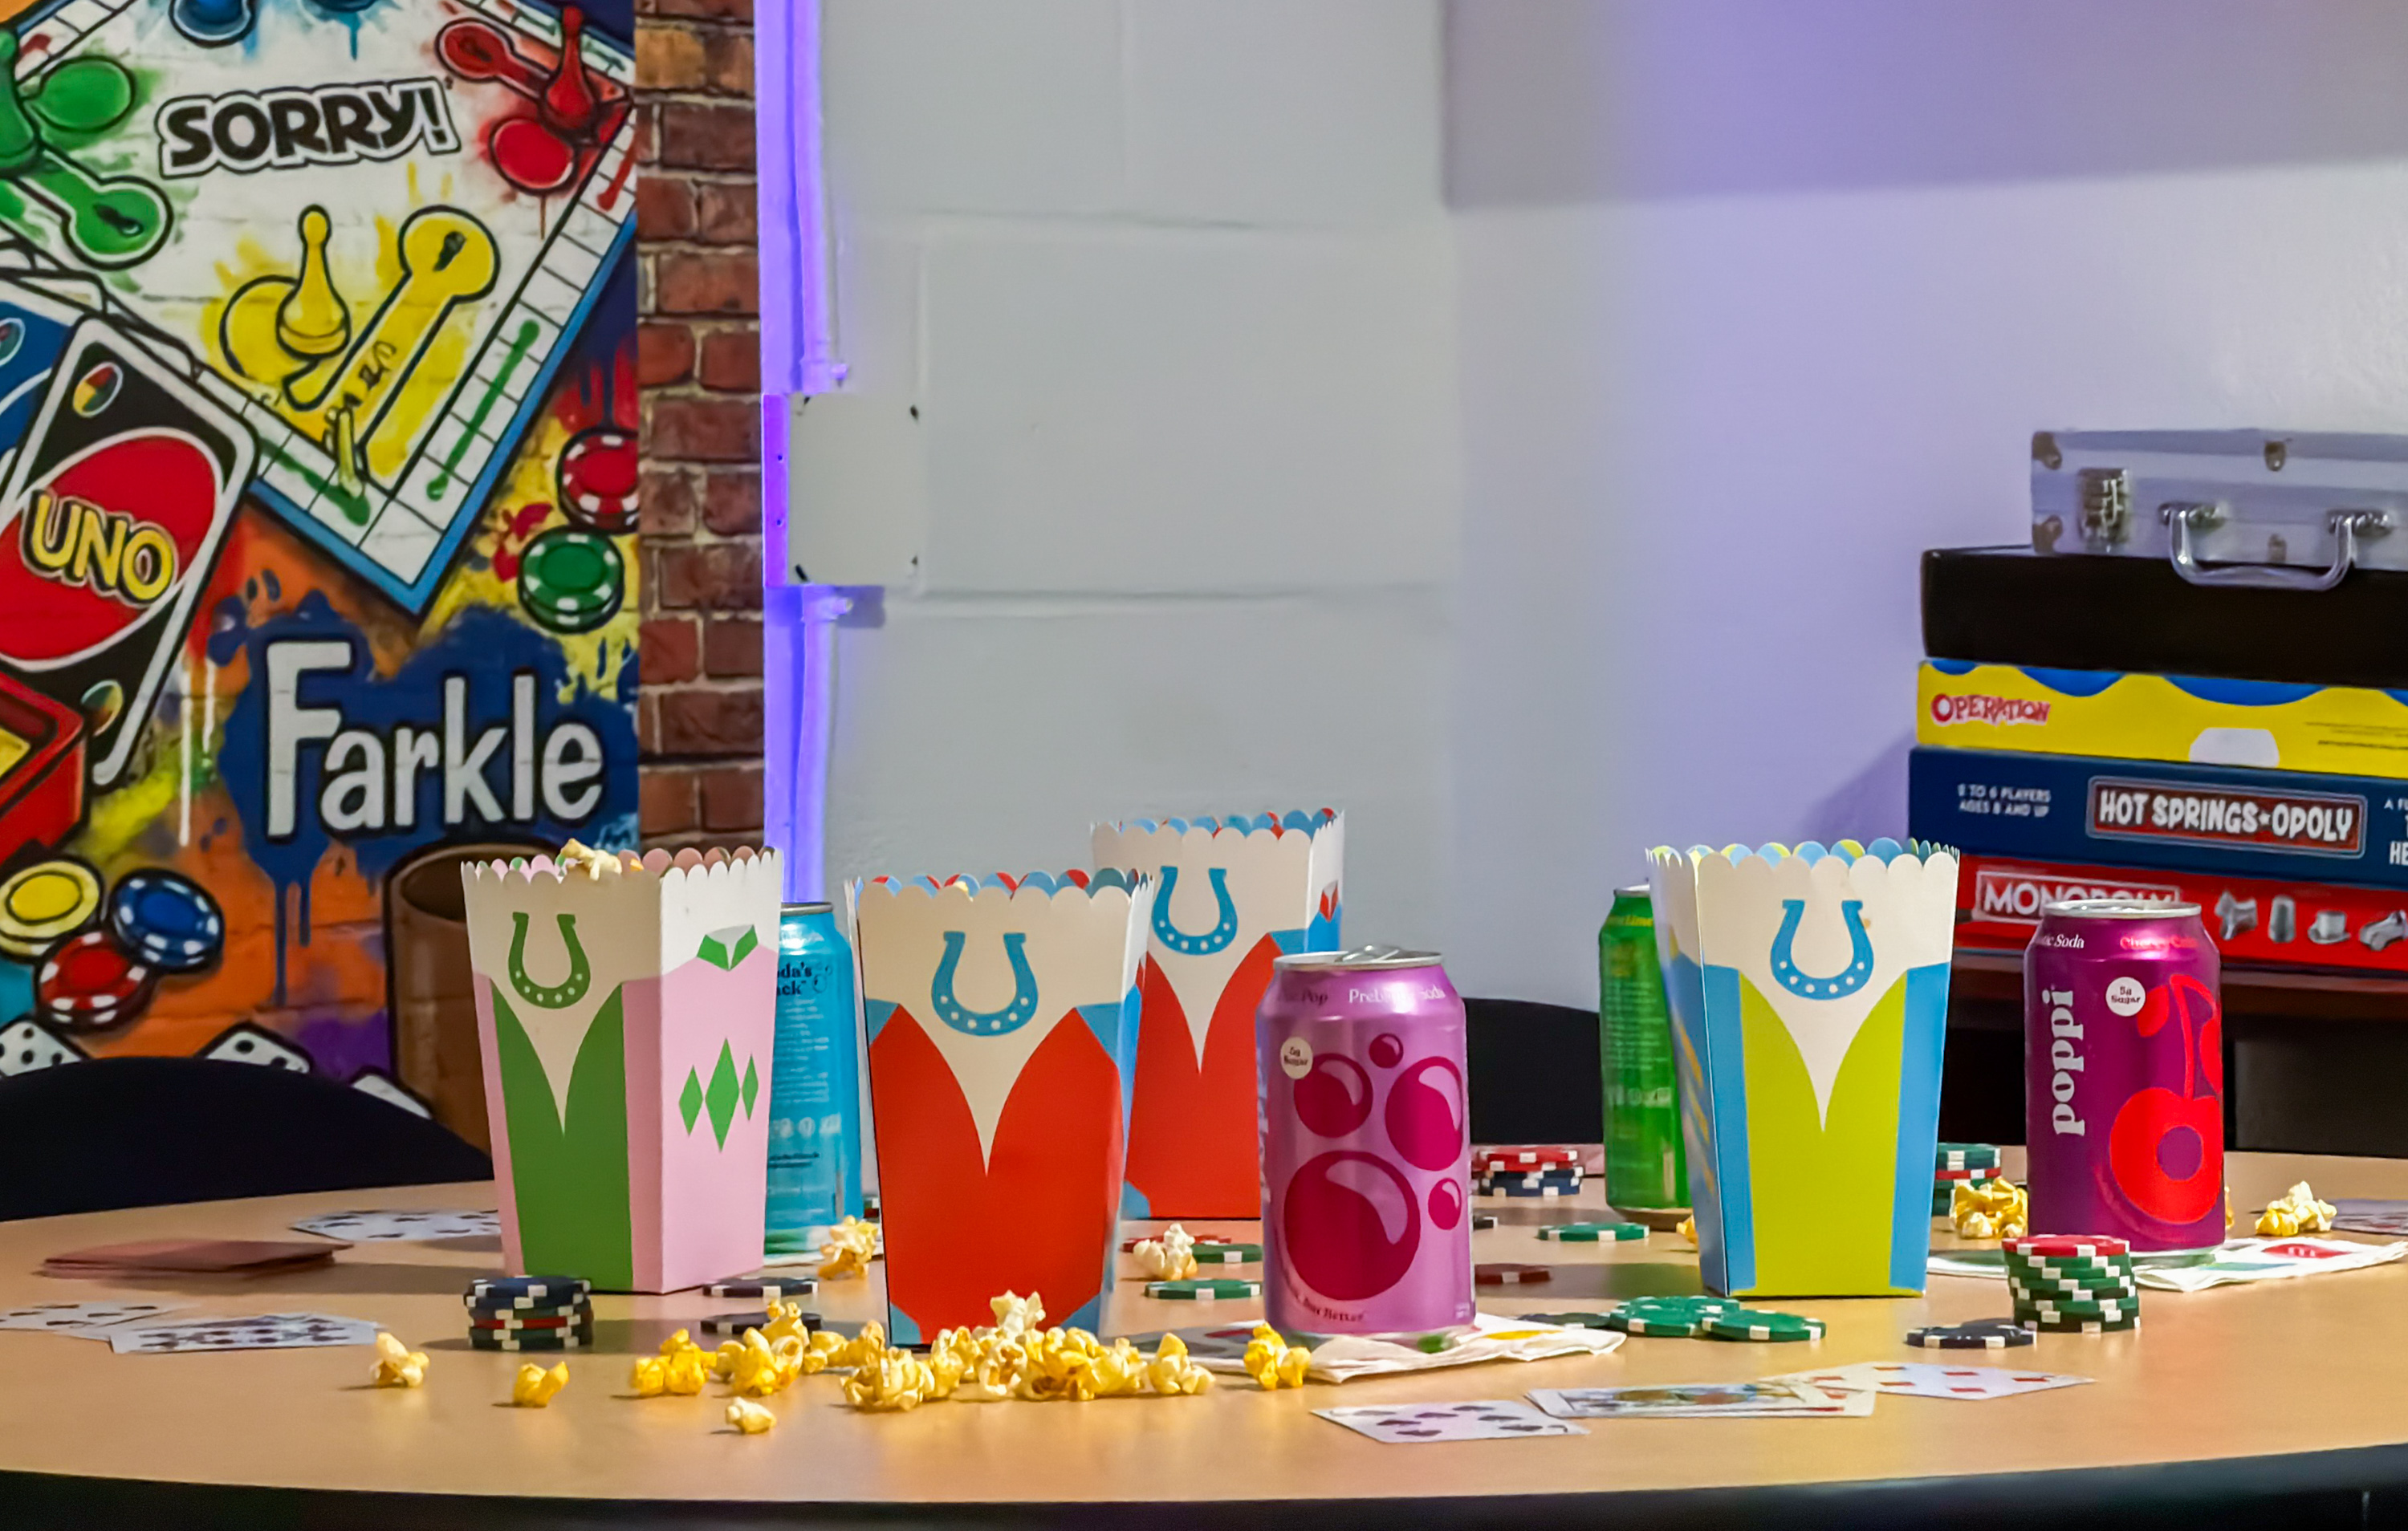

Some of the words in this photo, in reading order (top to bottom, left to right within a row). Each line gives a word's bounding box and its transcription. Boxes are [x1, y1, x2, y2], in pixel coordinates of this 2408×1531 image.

[165, 87, 449, 169] SORRY!
[26, 491, 176, 603] UNO
[1930, 693, 2051, 725] OPERATION
[265, 640, 604, 837] Farkle
[1959, 800, 1991, 814] AGES
[2000, 786, 2052, 803] PLAYERS
[2099, 790, 2150, 826] HOT
[2384, 797, 2394, 810] A
[2054, 933, 2085, 949] Soda
[777, 961, 812, 978] da's
[2041, 989, 2085, 1137] poppi
